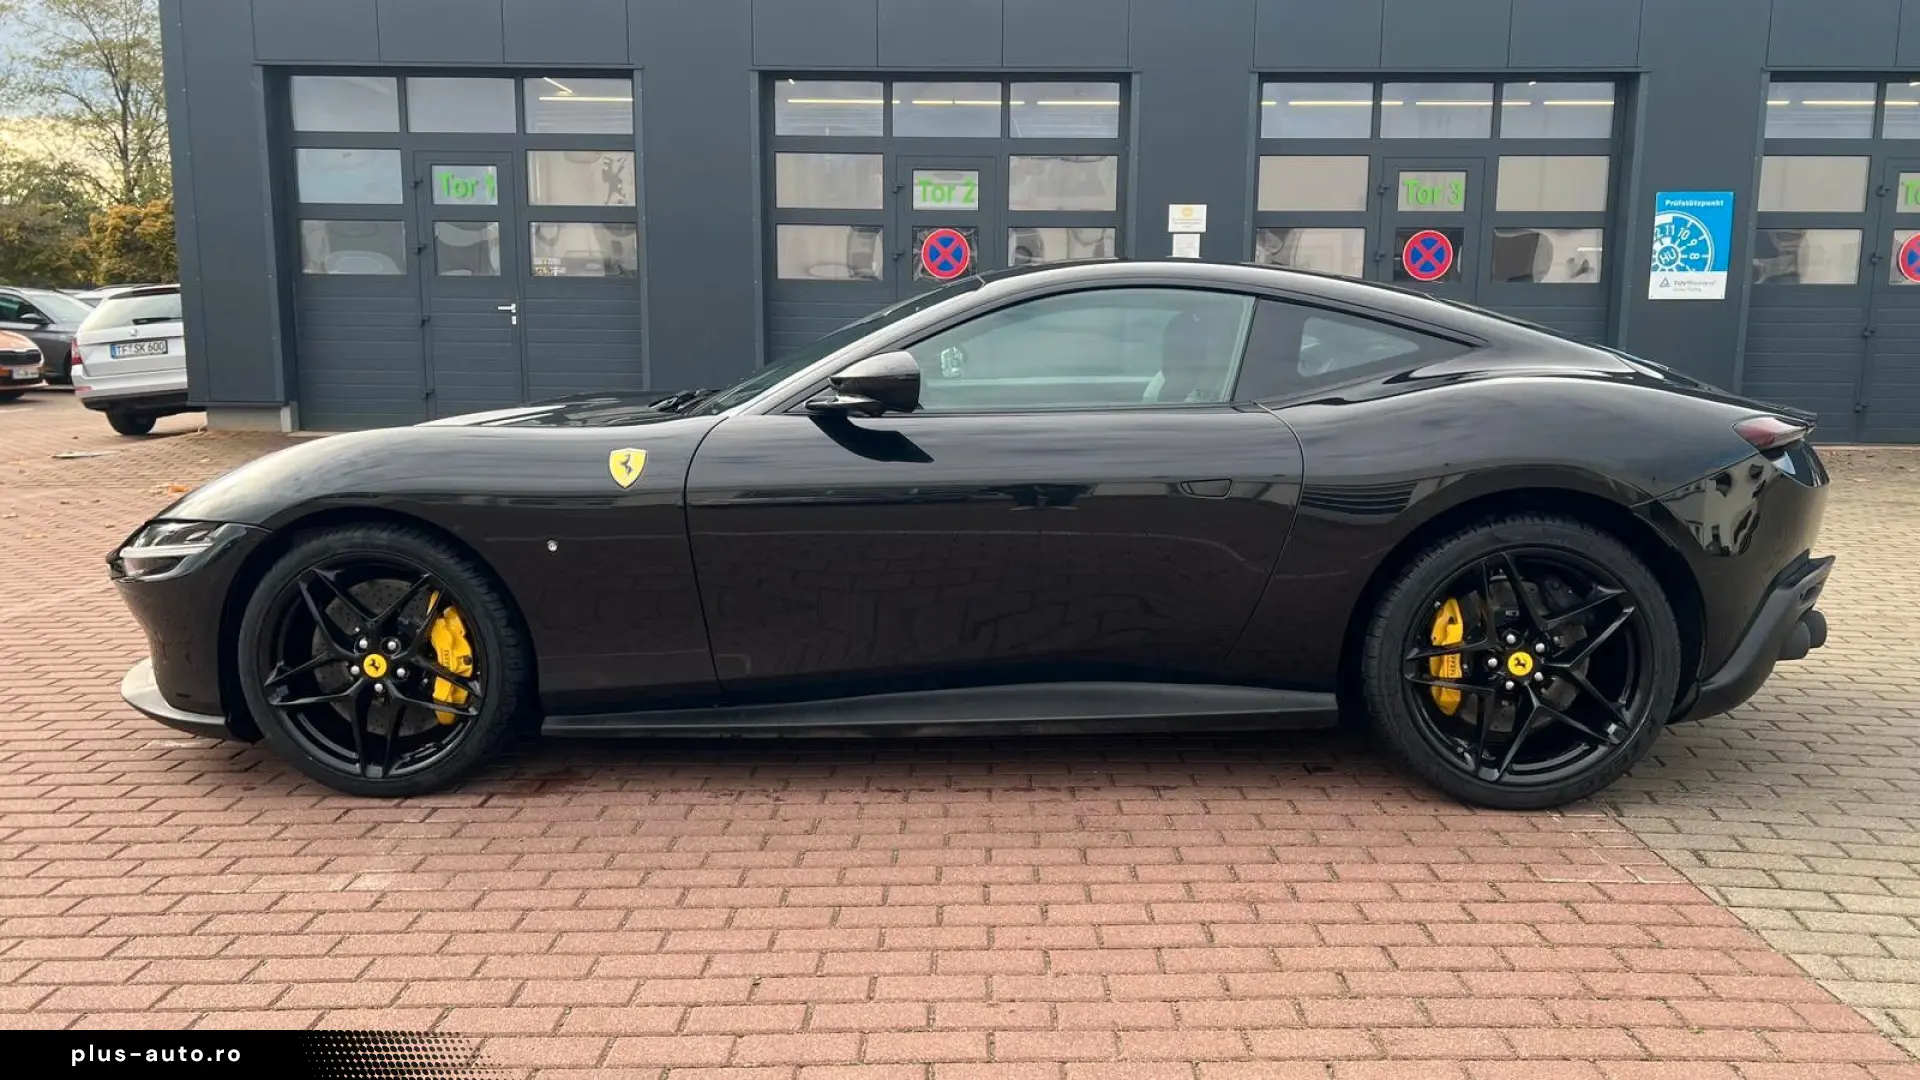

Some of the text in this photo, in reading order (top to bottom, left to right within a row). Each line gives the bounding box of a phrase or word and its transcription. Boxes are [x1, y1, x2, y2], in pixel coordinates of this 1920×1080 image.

[436, 172, 495, 198] Tor 1
[917, 177, 975, 204] Tor 2
[1403, 179, 1463, 205] Tor 3
[1665, 199, 1724, 208] Prüfstützpunkt
[1664, 224, 1675, 236] 11
[1678, 227, 1691, 241] 10
[1687, 238, 1698, 247] 9
[1659, 247, 1676, 265] HU
[1689, 252, 1700, 260] 8
[134, 343, 146, 354] SK
